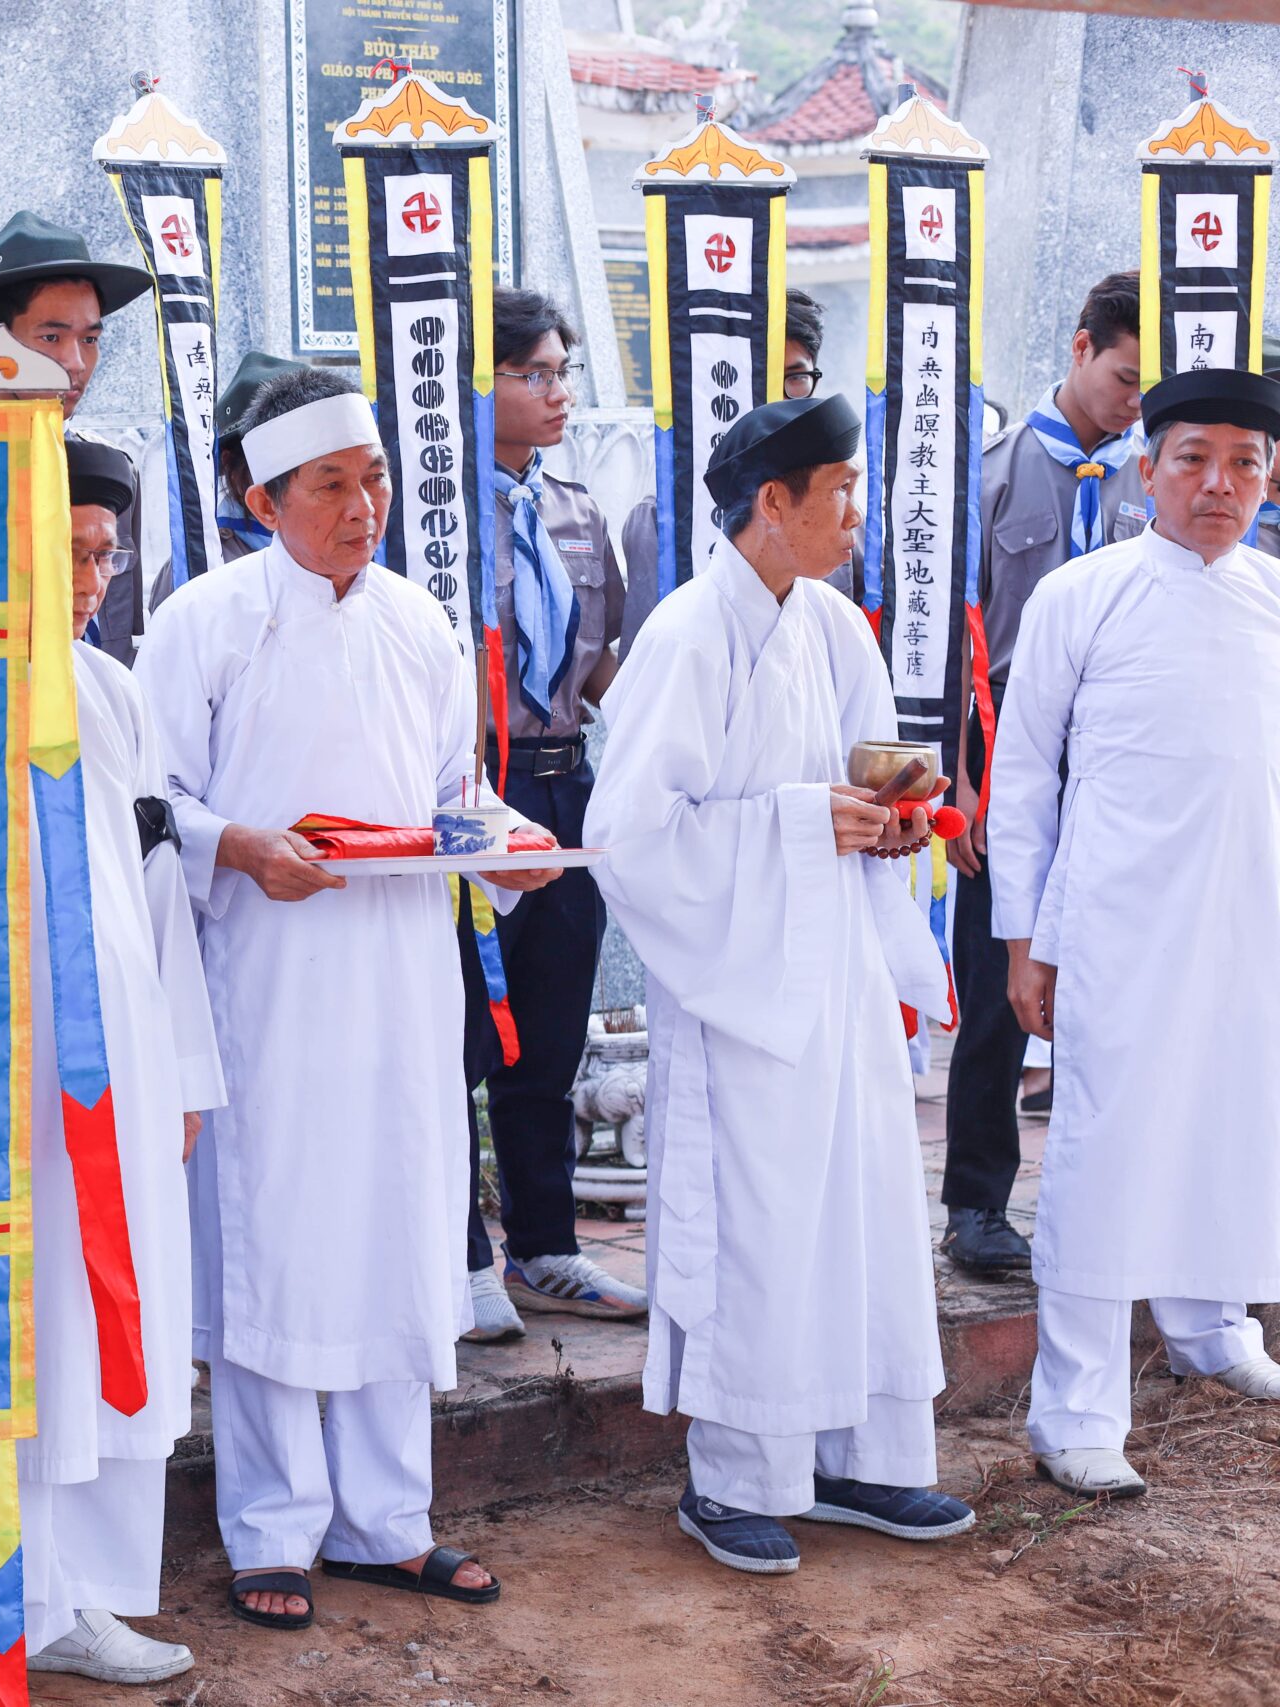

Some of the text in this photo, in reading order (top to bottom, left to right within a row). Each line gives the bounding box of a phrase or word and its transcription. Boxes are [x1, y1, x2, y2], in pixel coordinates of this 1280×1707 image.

[363, 37, 440, 59] BỬU THÁP
[321, 61, 353, 78] GIÁO
[410, 316, 445, 347] NAM
[412, 380, 445, 409] QUAN
[418, 476, 456, 507] QUÂN
[424, 540, 458, 570] BI
